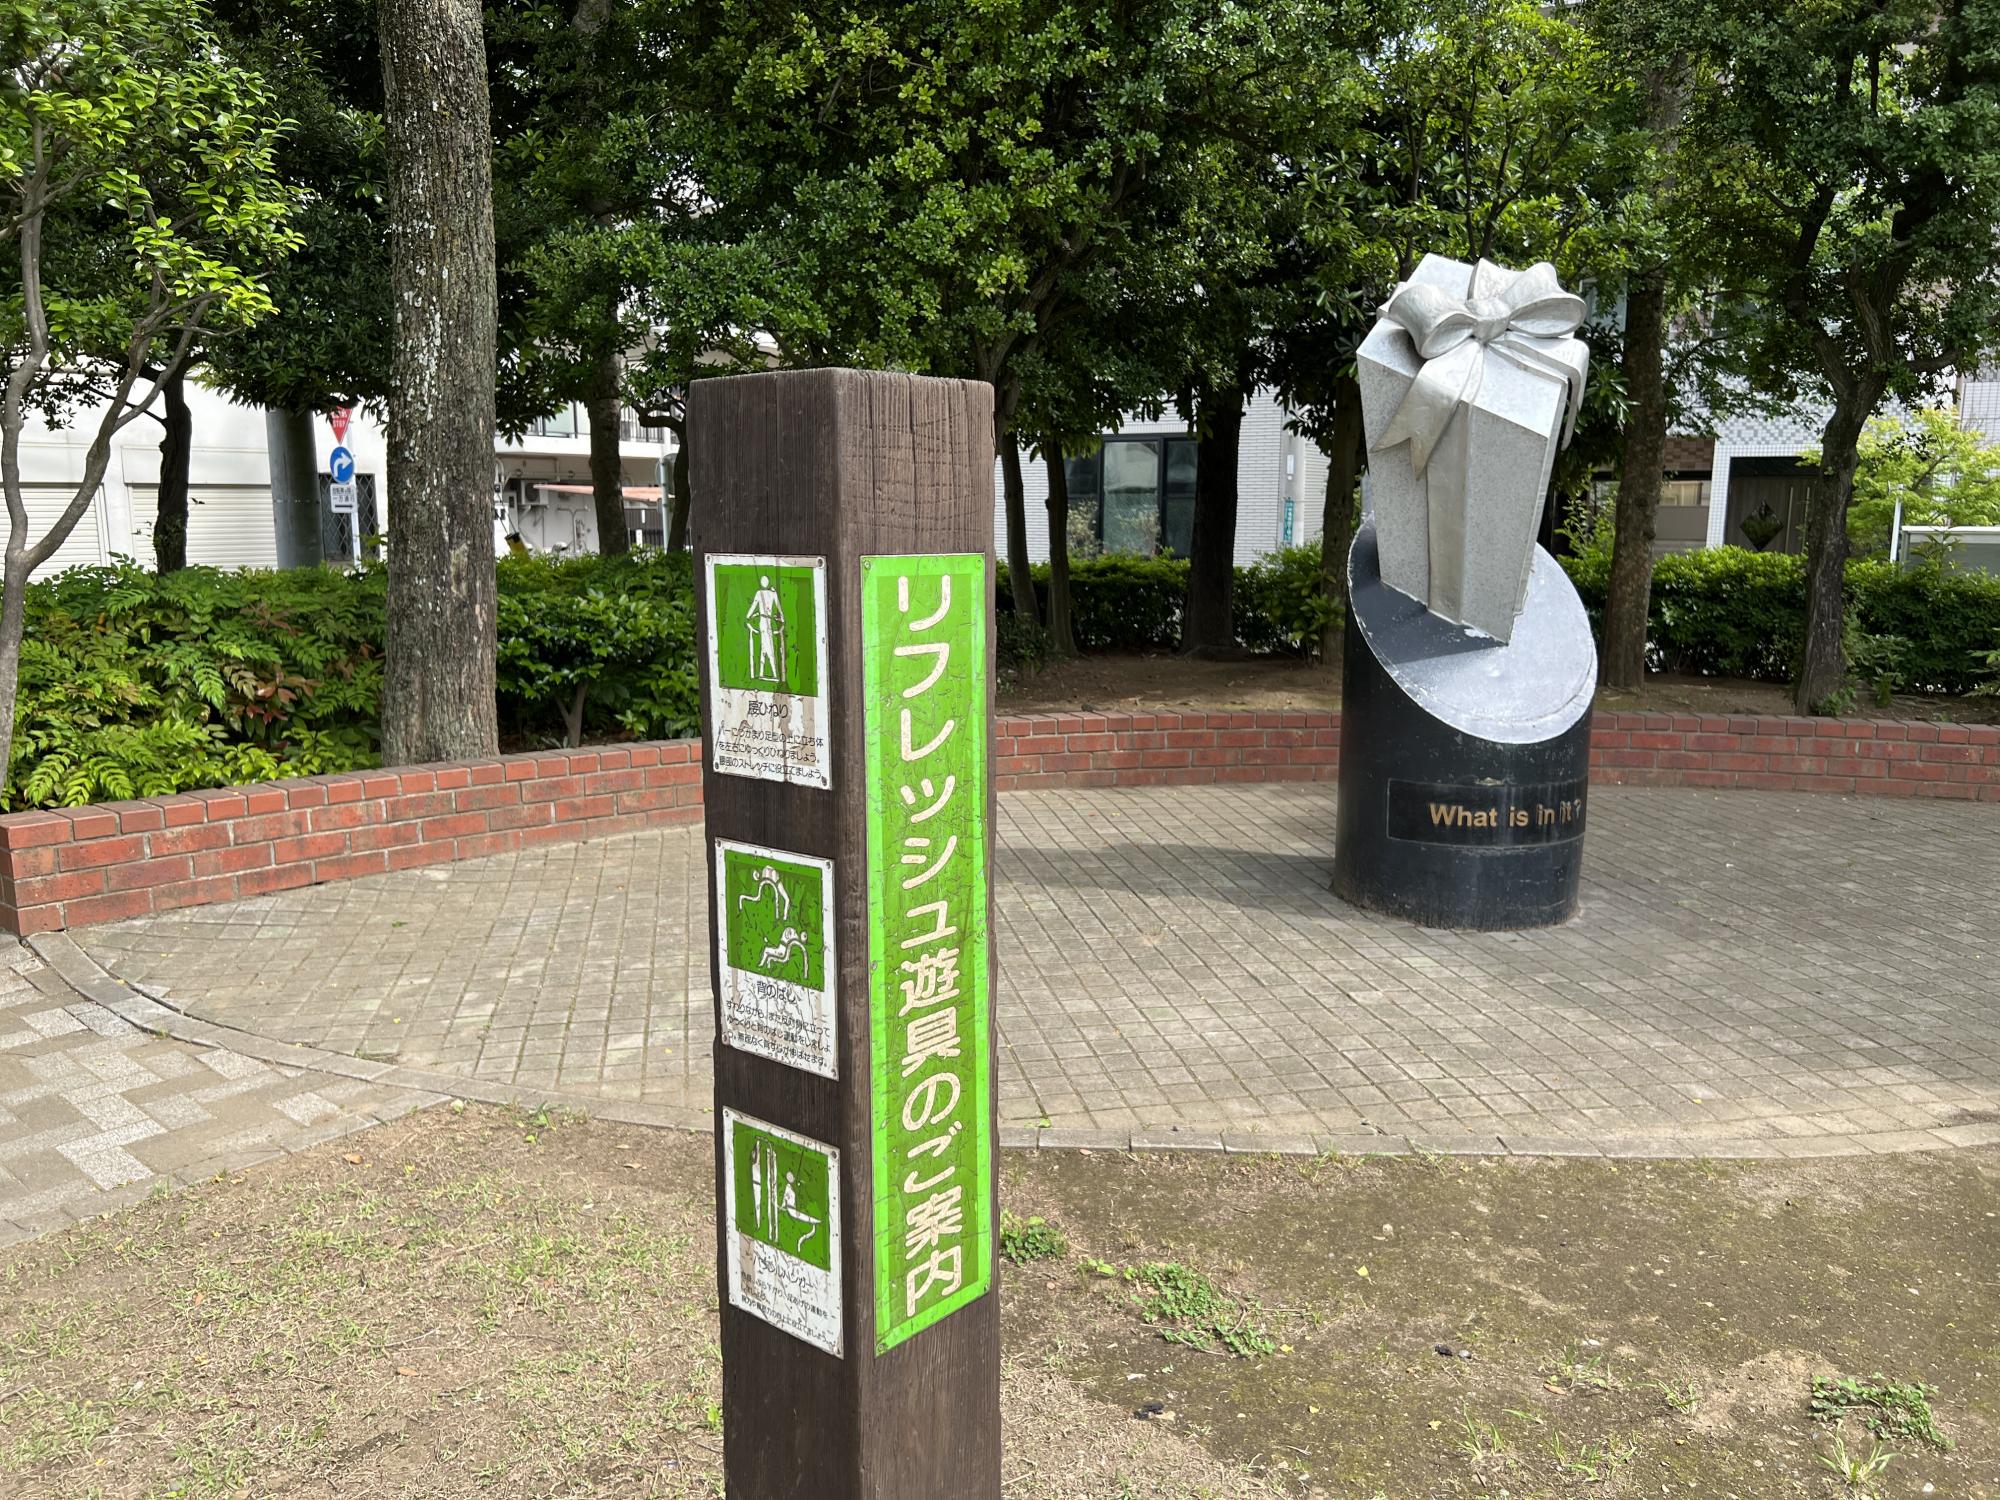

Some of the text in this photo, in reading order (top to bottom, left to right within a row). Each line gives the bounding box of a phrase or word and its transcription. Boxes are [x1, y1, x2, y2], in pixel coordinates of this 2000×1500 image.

[748, 700, 789, 718] 腰ひねり
[1429, 803, 1498, 828] What
[1510, 806, 1529, 827] is
[1538, 803, 1555, 826] in
[894, 575, 963, 1318] リフレッシュ遊具のご案内
